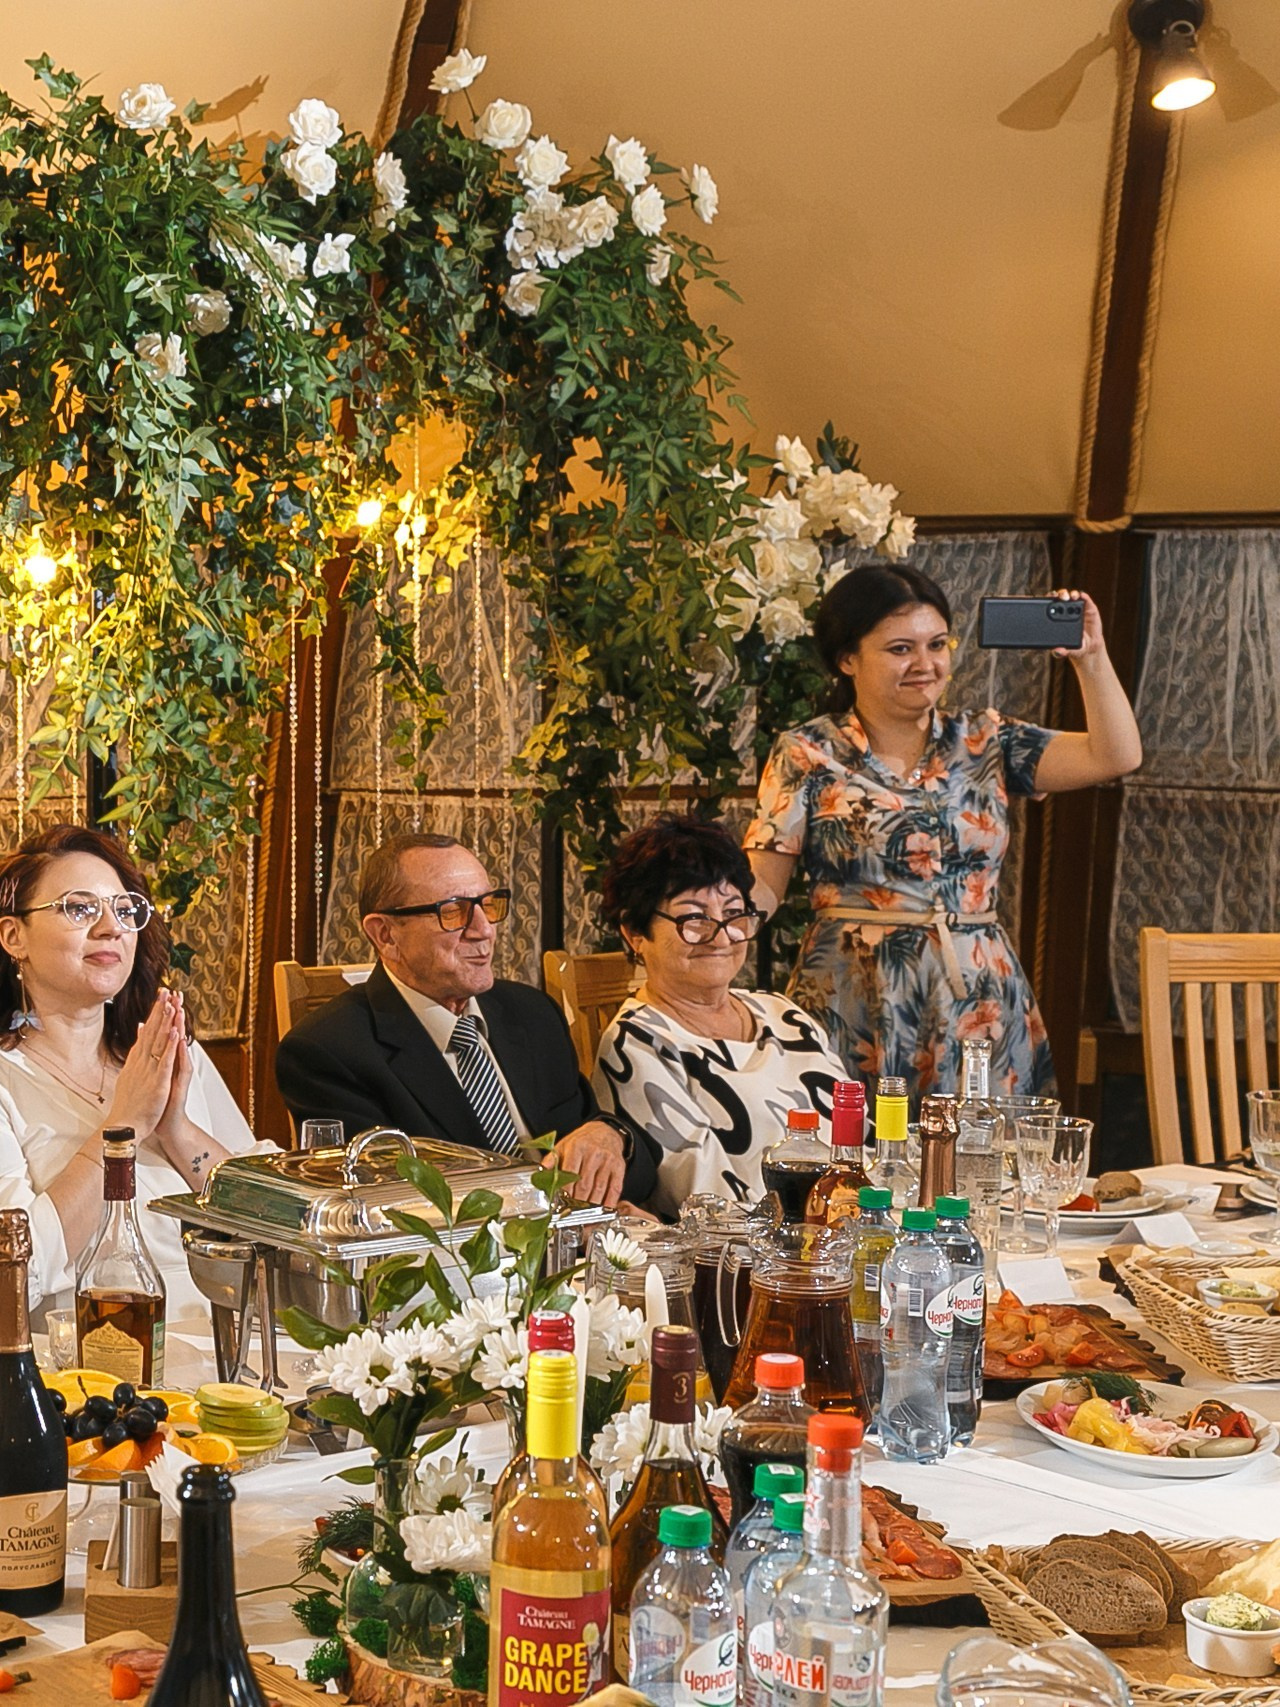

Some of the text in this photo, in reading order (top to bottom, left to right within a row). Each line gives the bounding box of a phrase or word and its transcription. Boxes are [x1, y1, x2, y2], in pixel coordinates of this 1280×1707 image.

[7, 1525, 54, 1539] Château
[524, 1605, 569, 1620] Château
[517, 1613, 576, 1630] TAMAGNE
[504, 1635, 588, 1668] GRAPE
[504, 1661, 588, 1695] DANCE
